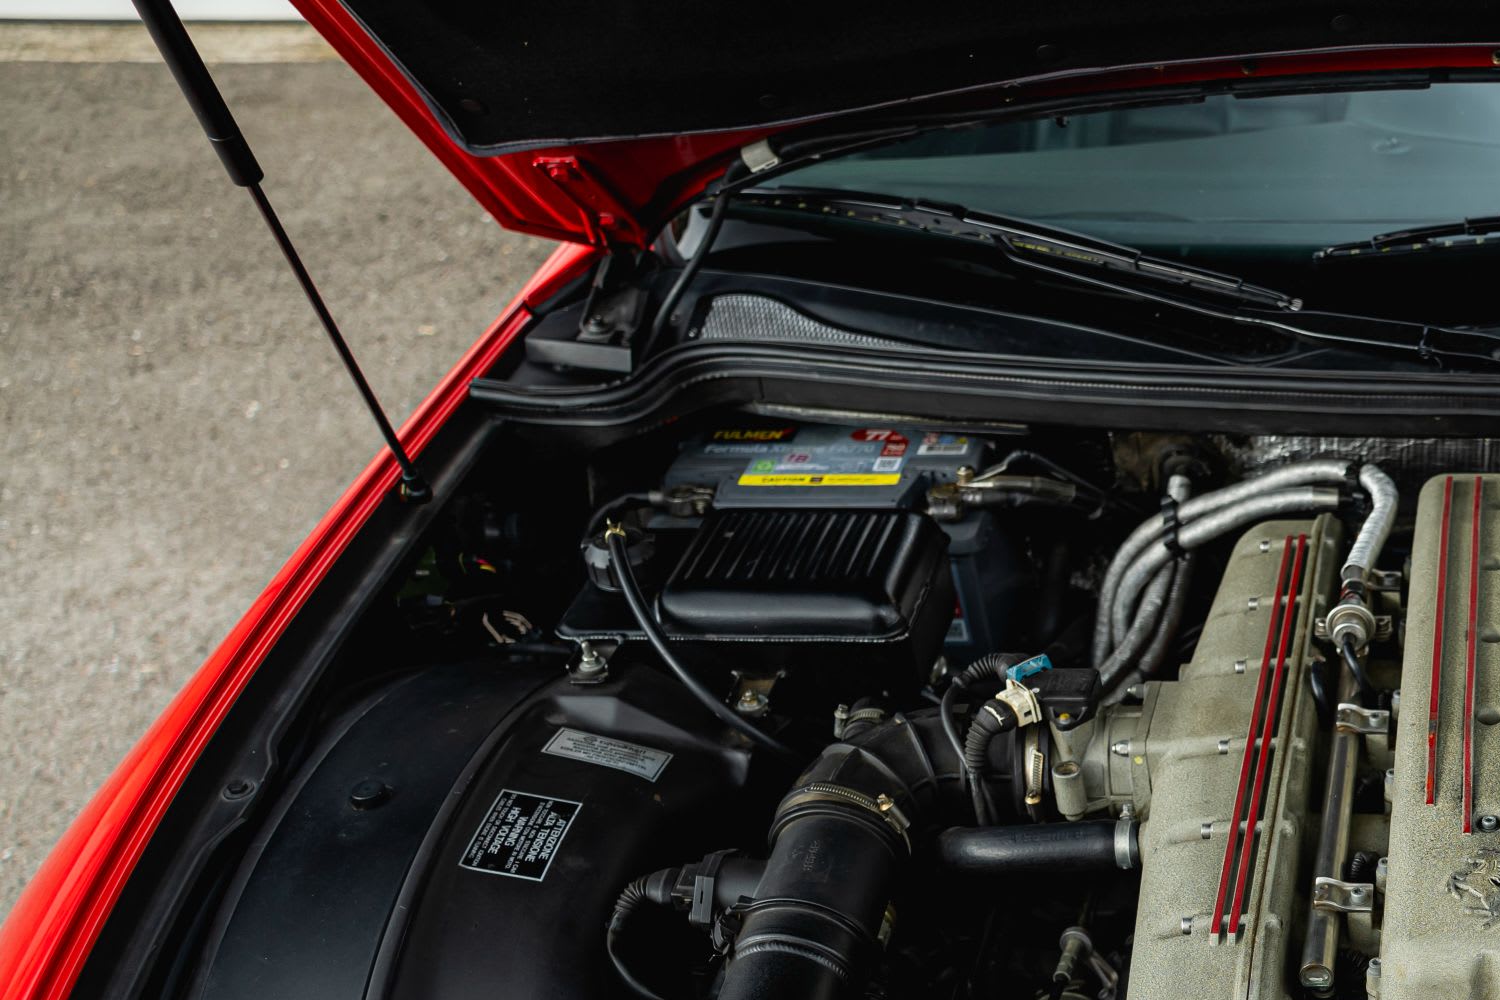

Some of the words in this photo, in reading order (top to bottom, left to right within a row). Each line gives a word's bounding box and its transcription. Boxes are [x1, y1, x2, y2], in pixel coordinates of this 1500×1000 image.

[713, 430, 783, 440] FULMEN
[866, 430, 891, 441] 77
[704, 443, 768, 454] Formula
[505, 807, 521, 822] HIGH
[544, 811, 557, 826] ALTA
[504, 817, 528, 846] WARNING
[487, 825, 511, 854] VOLTAGE
[525, 829, 550, 862] TENSIONE
[538, 819, 566, 860] ATTENZIONE
